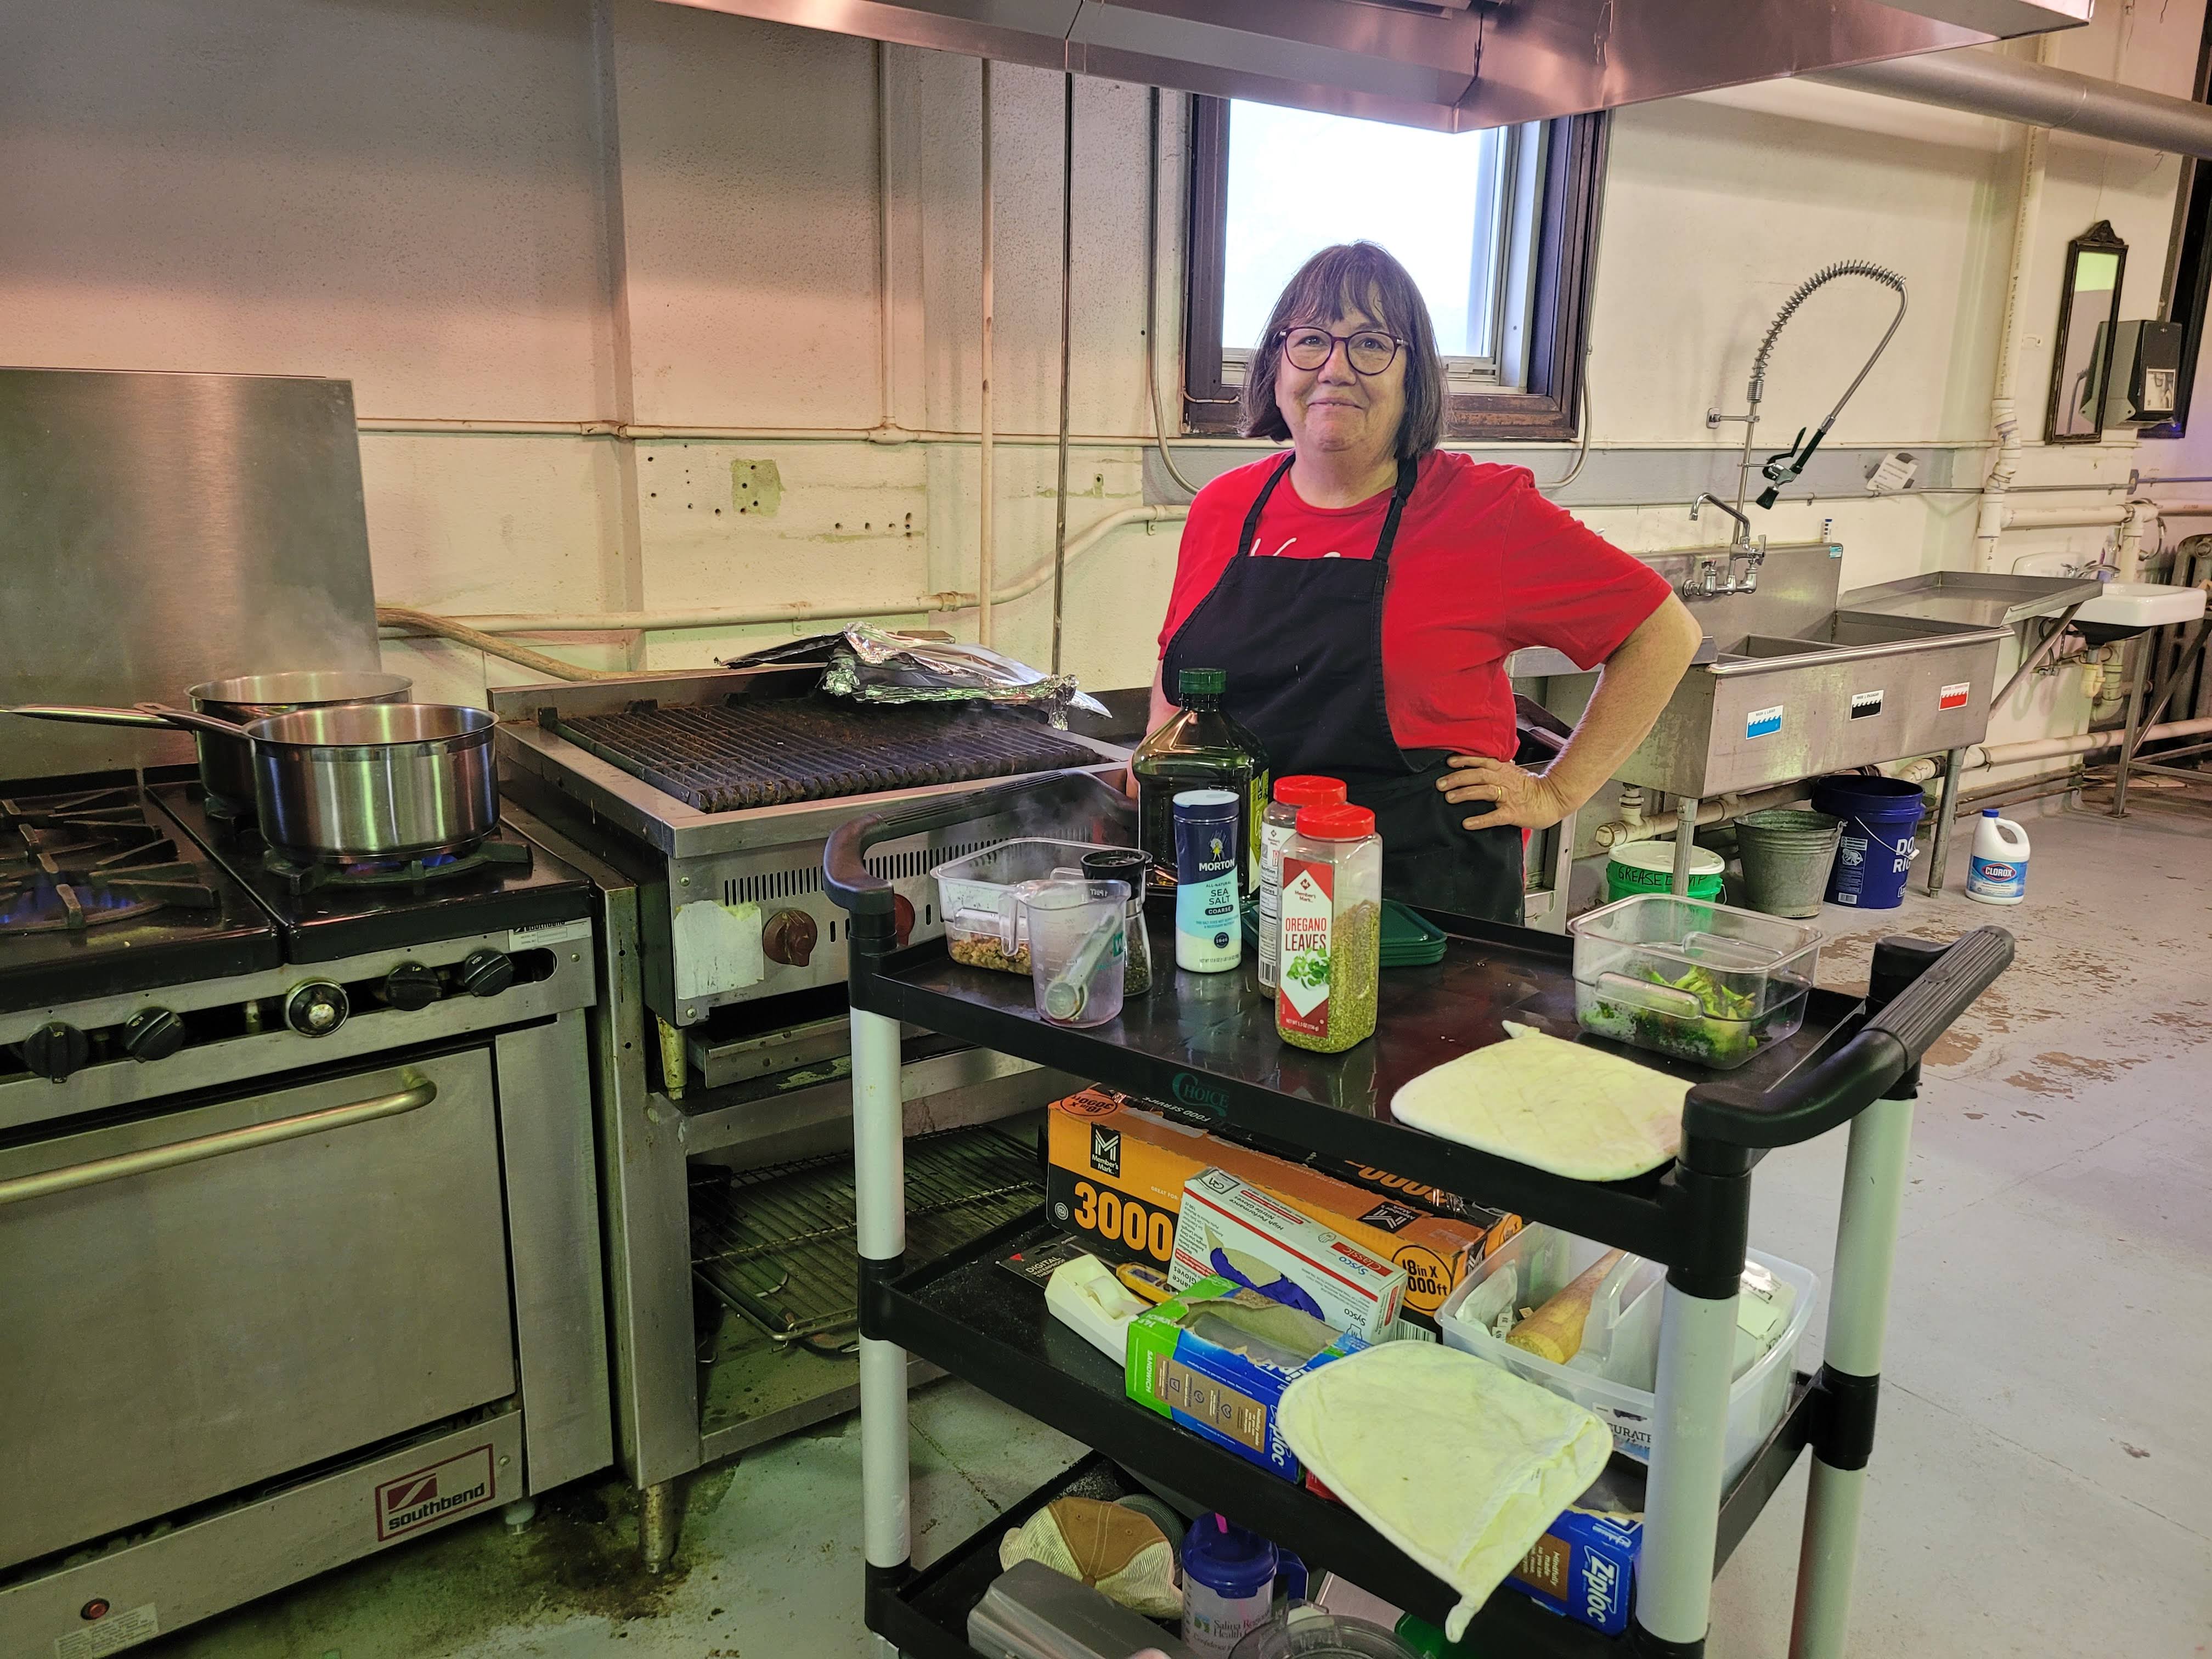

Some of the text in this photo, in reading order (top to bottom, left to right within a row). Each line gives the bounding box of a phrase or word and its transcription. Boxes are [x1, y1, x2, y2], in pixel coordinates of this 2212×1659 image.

[1199, 857, 1235, 872] MORTON
[1985, 867, 2012, 877] CLOROX
[1618, 866, 1707, 887] GREASE DMP
[1209, 895, 1231, 905] SALT
[1211, 888, 1229, 897] SEA
[1208, 906, 1231, 915] COARSE
[1285, 917, 1327, 932] OREGANO
[1285, 934, 1327, 951] LEAVES
[1172, 1073, 1229, 1116] CHOICE
[1183, 1110, 1212, 1122] FOOD
[1092, 1154, 1119, 1170] Member's
[1229, 1199, 1268, 1222] Performance
[1234, 1196, 1275, 1220] Nitrile Gloves
[1074, 1181, 1174, 1262] 3000
[1268, 1220, 1284, 1231] High
[1025, 1256, 1062, 1273] DIGITAL
[1031, 1259, 1065, 1276] WATERPROOF
[1339, 1256, 1368, 1276] Sysco
[1342, 1247, 1382, 1271] Classic
[1036, 1268, 1054, 1279] THERM
[1173, 1266, 1197, 1284] Gloves
[1402, 1259, 1438, 1279] 18in X
[1406, 1276, 1448, 1296] 000ft
[1344, 1308, 1367, 1326] Sysco
[1269, 1422, 1290, 1467] ploc
[389, 1482, 486, 1530] southbend
[1550, 1551, 1561, 1586] Mindfully
[1582, 1555, 1616, 1624] Ziploc
[1214, 1620, 1241, 1630] Salina
[1214, 1628, 1242, 1638] Health
